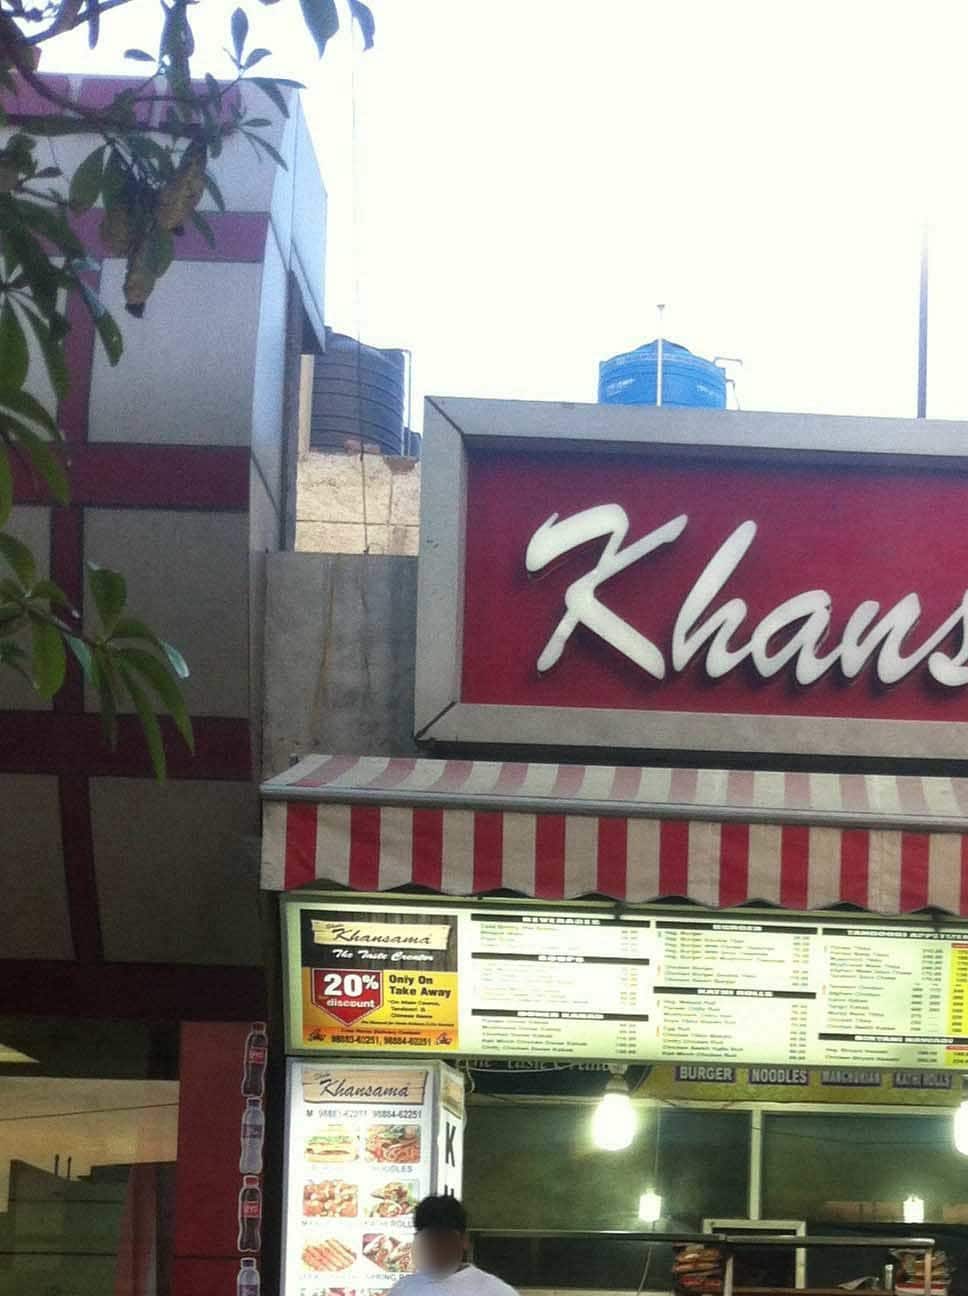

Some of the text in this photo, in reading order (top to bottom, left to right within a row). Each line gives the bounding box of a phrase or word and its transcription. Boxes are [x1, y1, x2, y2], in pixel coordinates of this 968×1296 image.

[331, 927, 432, 946] Khansama
[332, 949, 354, 959] The
[358, 950, 388, 960] Taste
[323, 973, 380, 997] 20%
[388, 974, 433, 987] Only On
[388, 986, 452, 999] Take Away
[326, 998, 376, 1009] discount
[678, 1065, 734, 1082] BURGER
[750, 1067, 808, 1085] NOODLES
[319, 1077, 410, 1098] Khansama
